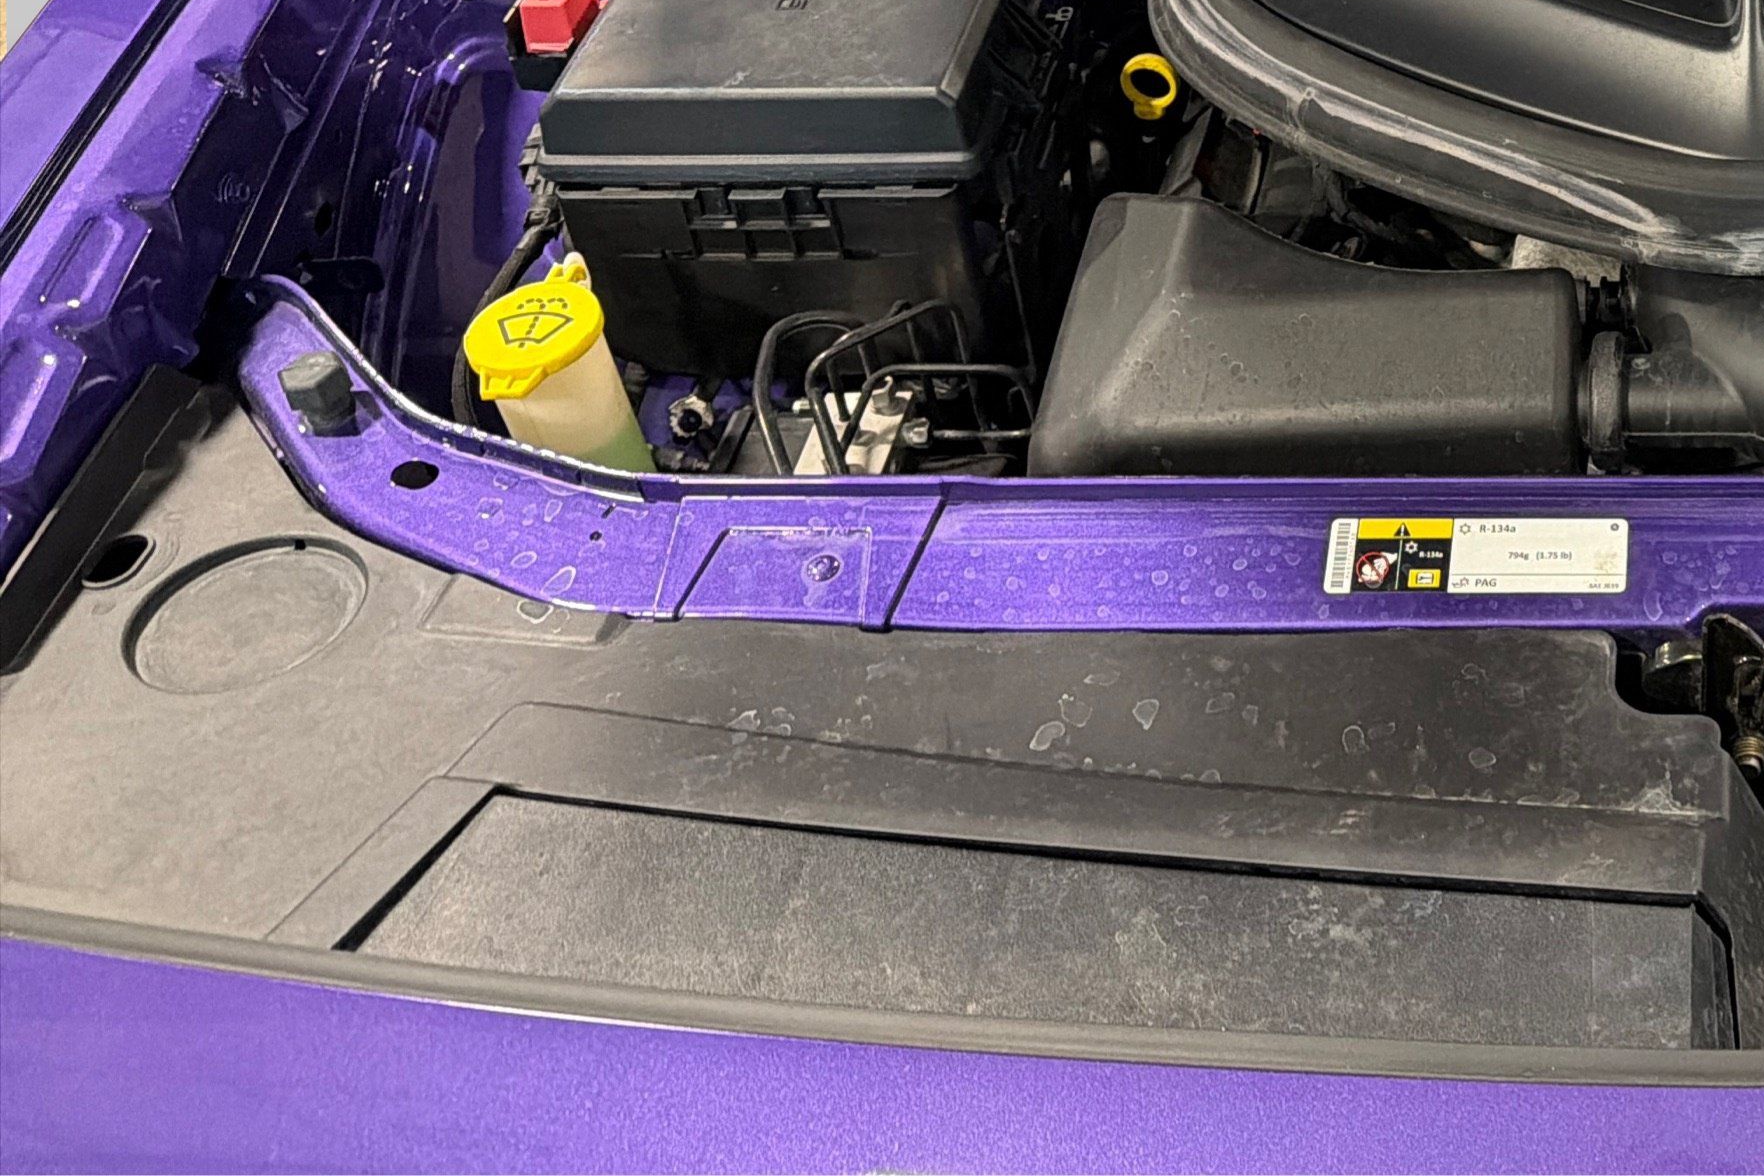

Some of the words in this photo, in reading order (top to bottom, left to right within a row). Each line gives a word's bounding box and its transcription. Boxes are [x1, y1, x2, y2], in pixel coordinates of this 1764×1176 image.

[1479, 524, 1516, 533] R-134a
[1508, 551, 1529, 560] 794g
[1536, 551, 1558, 561] (1.75
[1560, 551, 1572, 561] lb)
[1474, 579, 1497, 588] PAG
